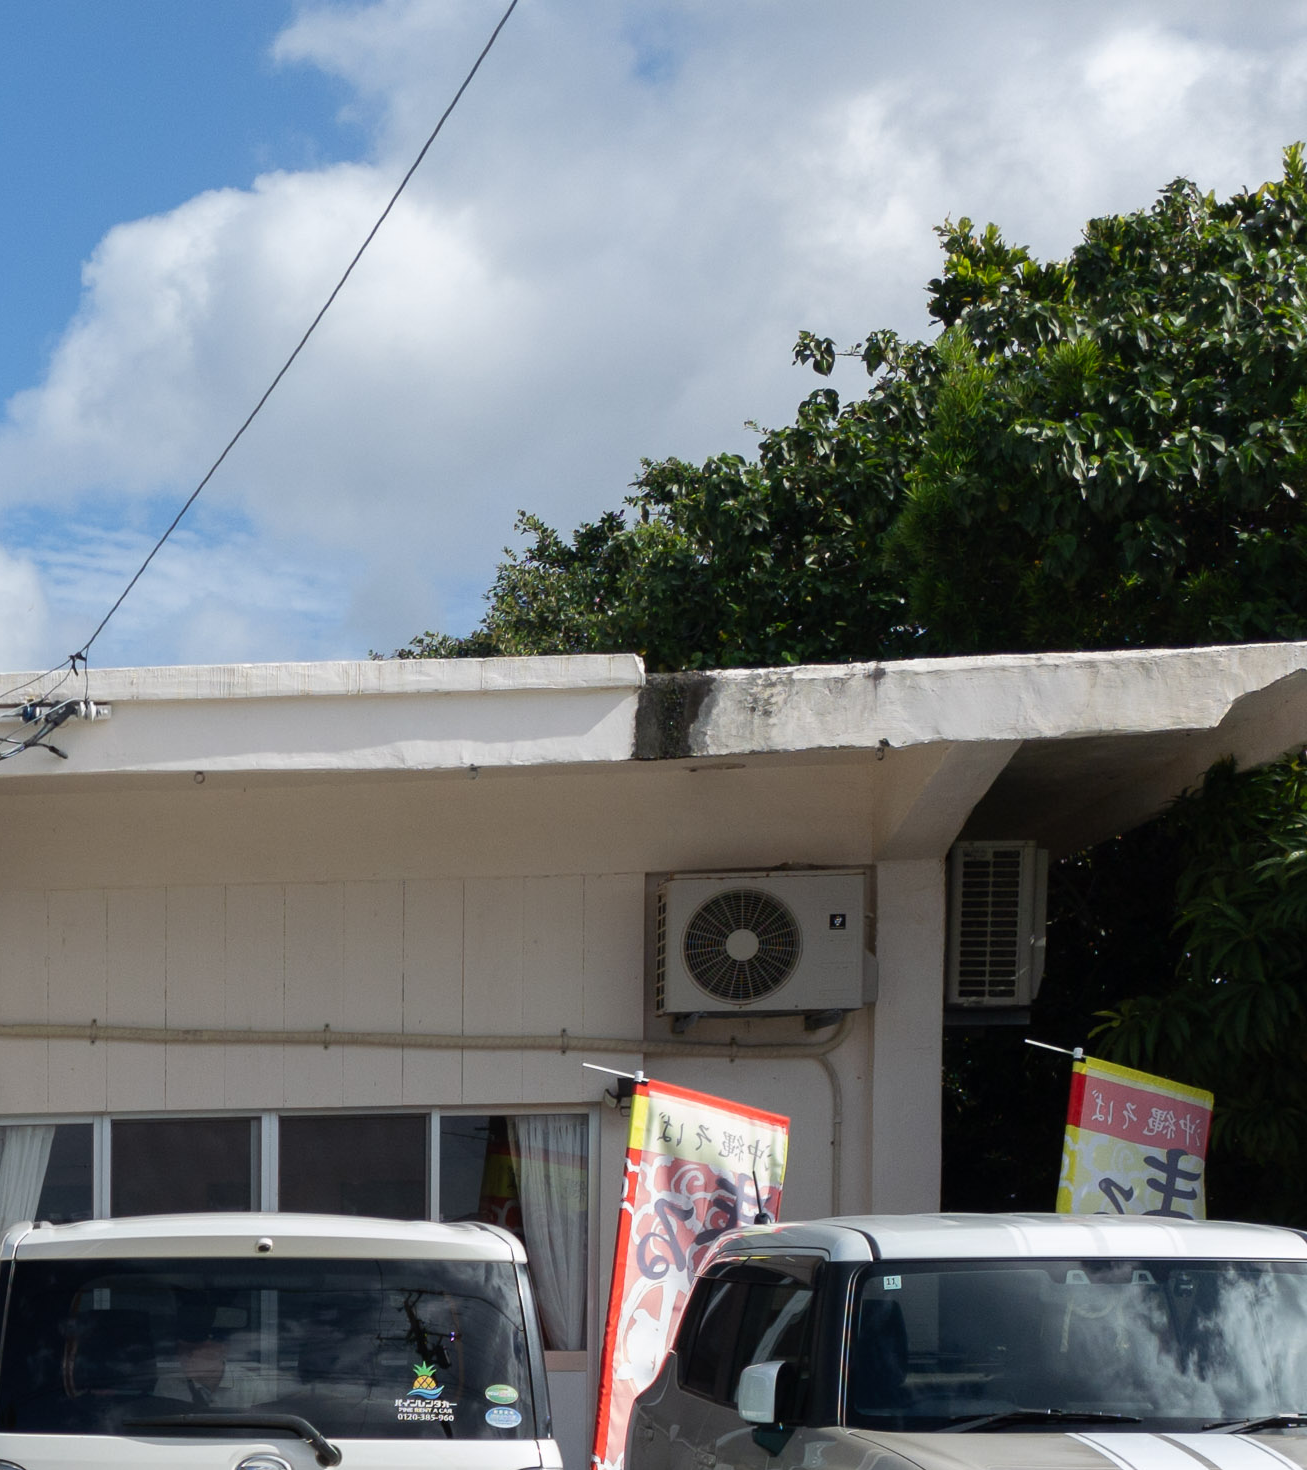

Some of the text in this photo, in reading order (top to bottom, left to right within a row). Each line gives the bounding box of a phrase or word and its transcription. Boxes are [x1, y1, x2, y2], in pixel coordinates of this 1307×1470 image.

[394, 1399, 457, 1408] パインレンタカー
[397, 1413, 455, 1422] 0120-385-960
